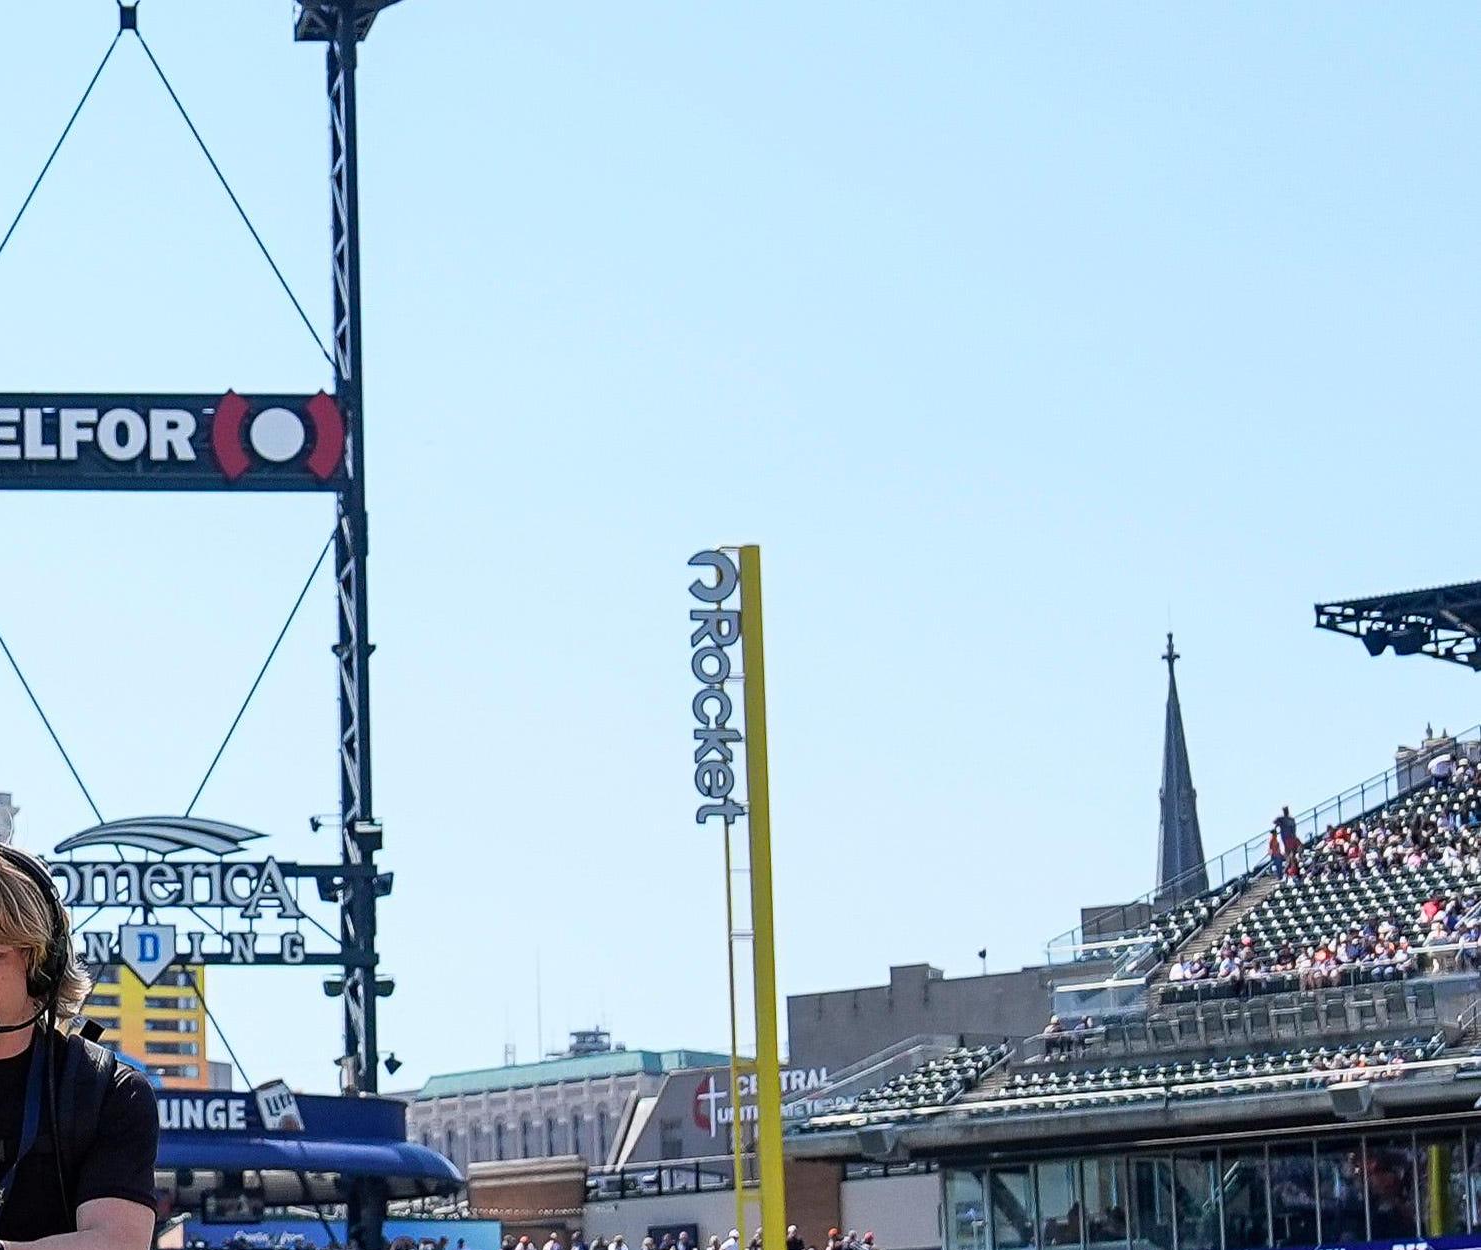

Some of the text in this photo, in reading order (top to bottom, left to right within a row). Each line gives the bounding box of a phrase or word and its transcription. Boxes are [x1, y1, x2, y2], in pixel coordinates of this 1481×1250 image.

[689, 609, 749, 824] Rocket
[737, 1067, 834, 1097] CTRAL
[157, 1098, 247, 1131] UNGE
